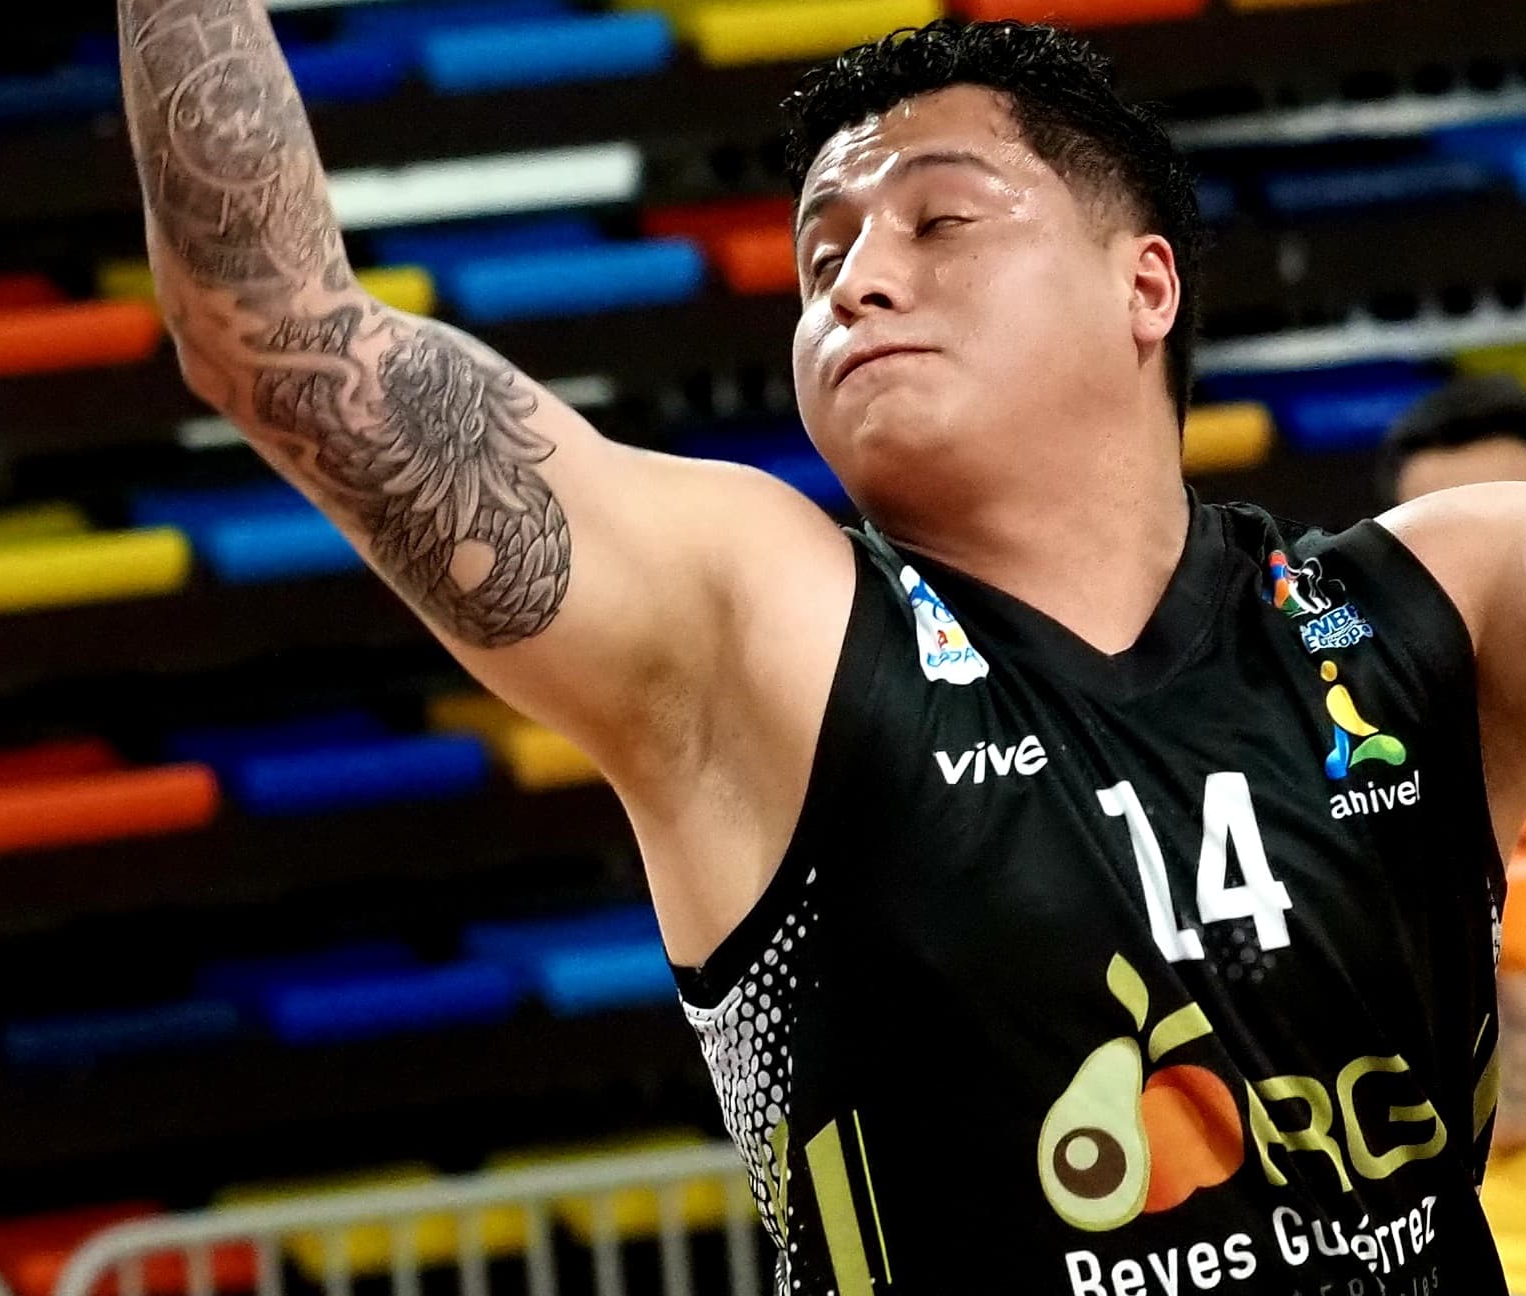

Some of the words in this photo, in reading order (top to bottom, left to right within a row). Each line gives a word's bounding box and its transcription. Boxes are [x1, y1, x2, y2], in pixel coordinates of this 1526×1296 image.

[935, 734, 1049, 785] vive
[1097, 771, 1293, 963] 14
[1246, 1053, 1448, 1193] RG
